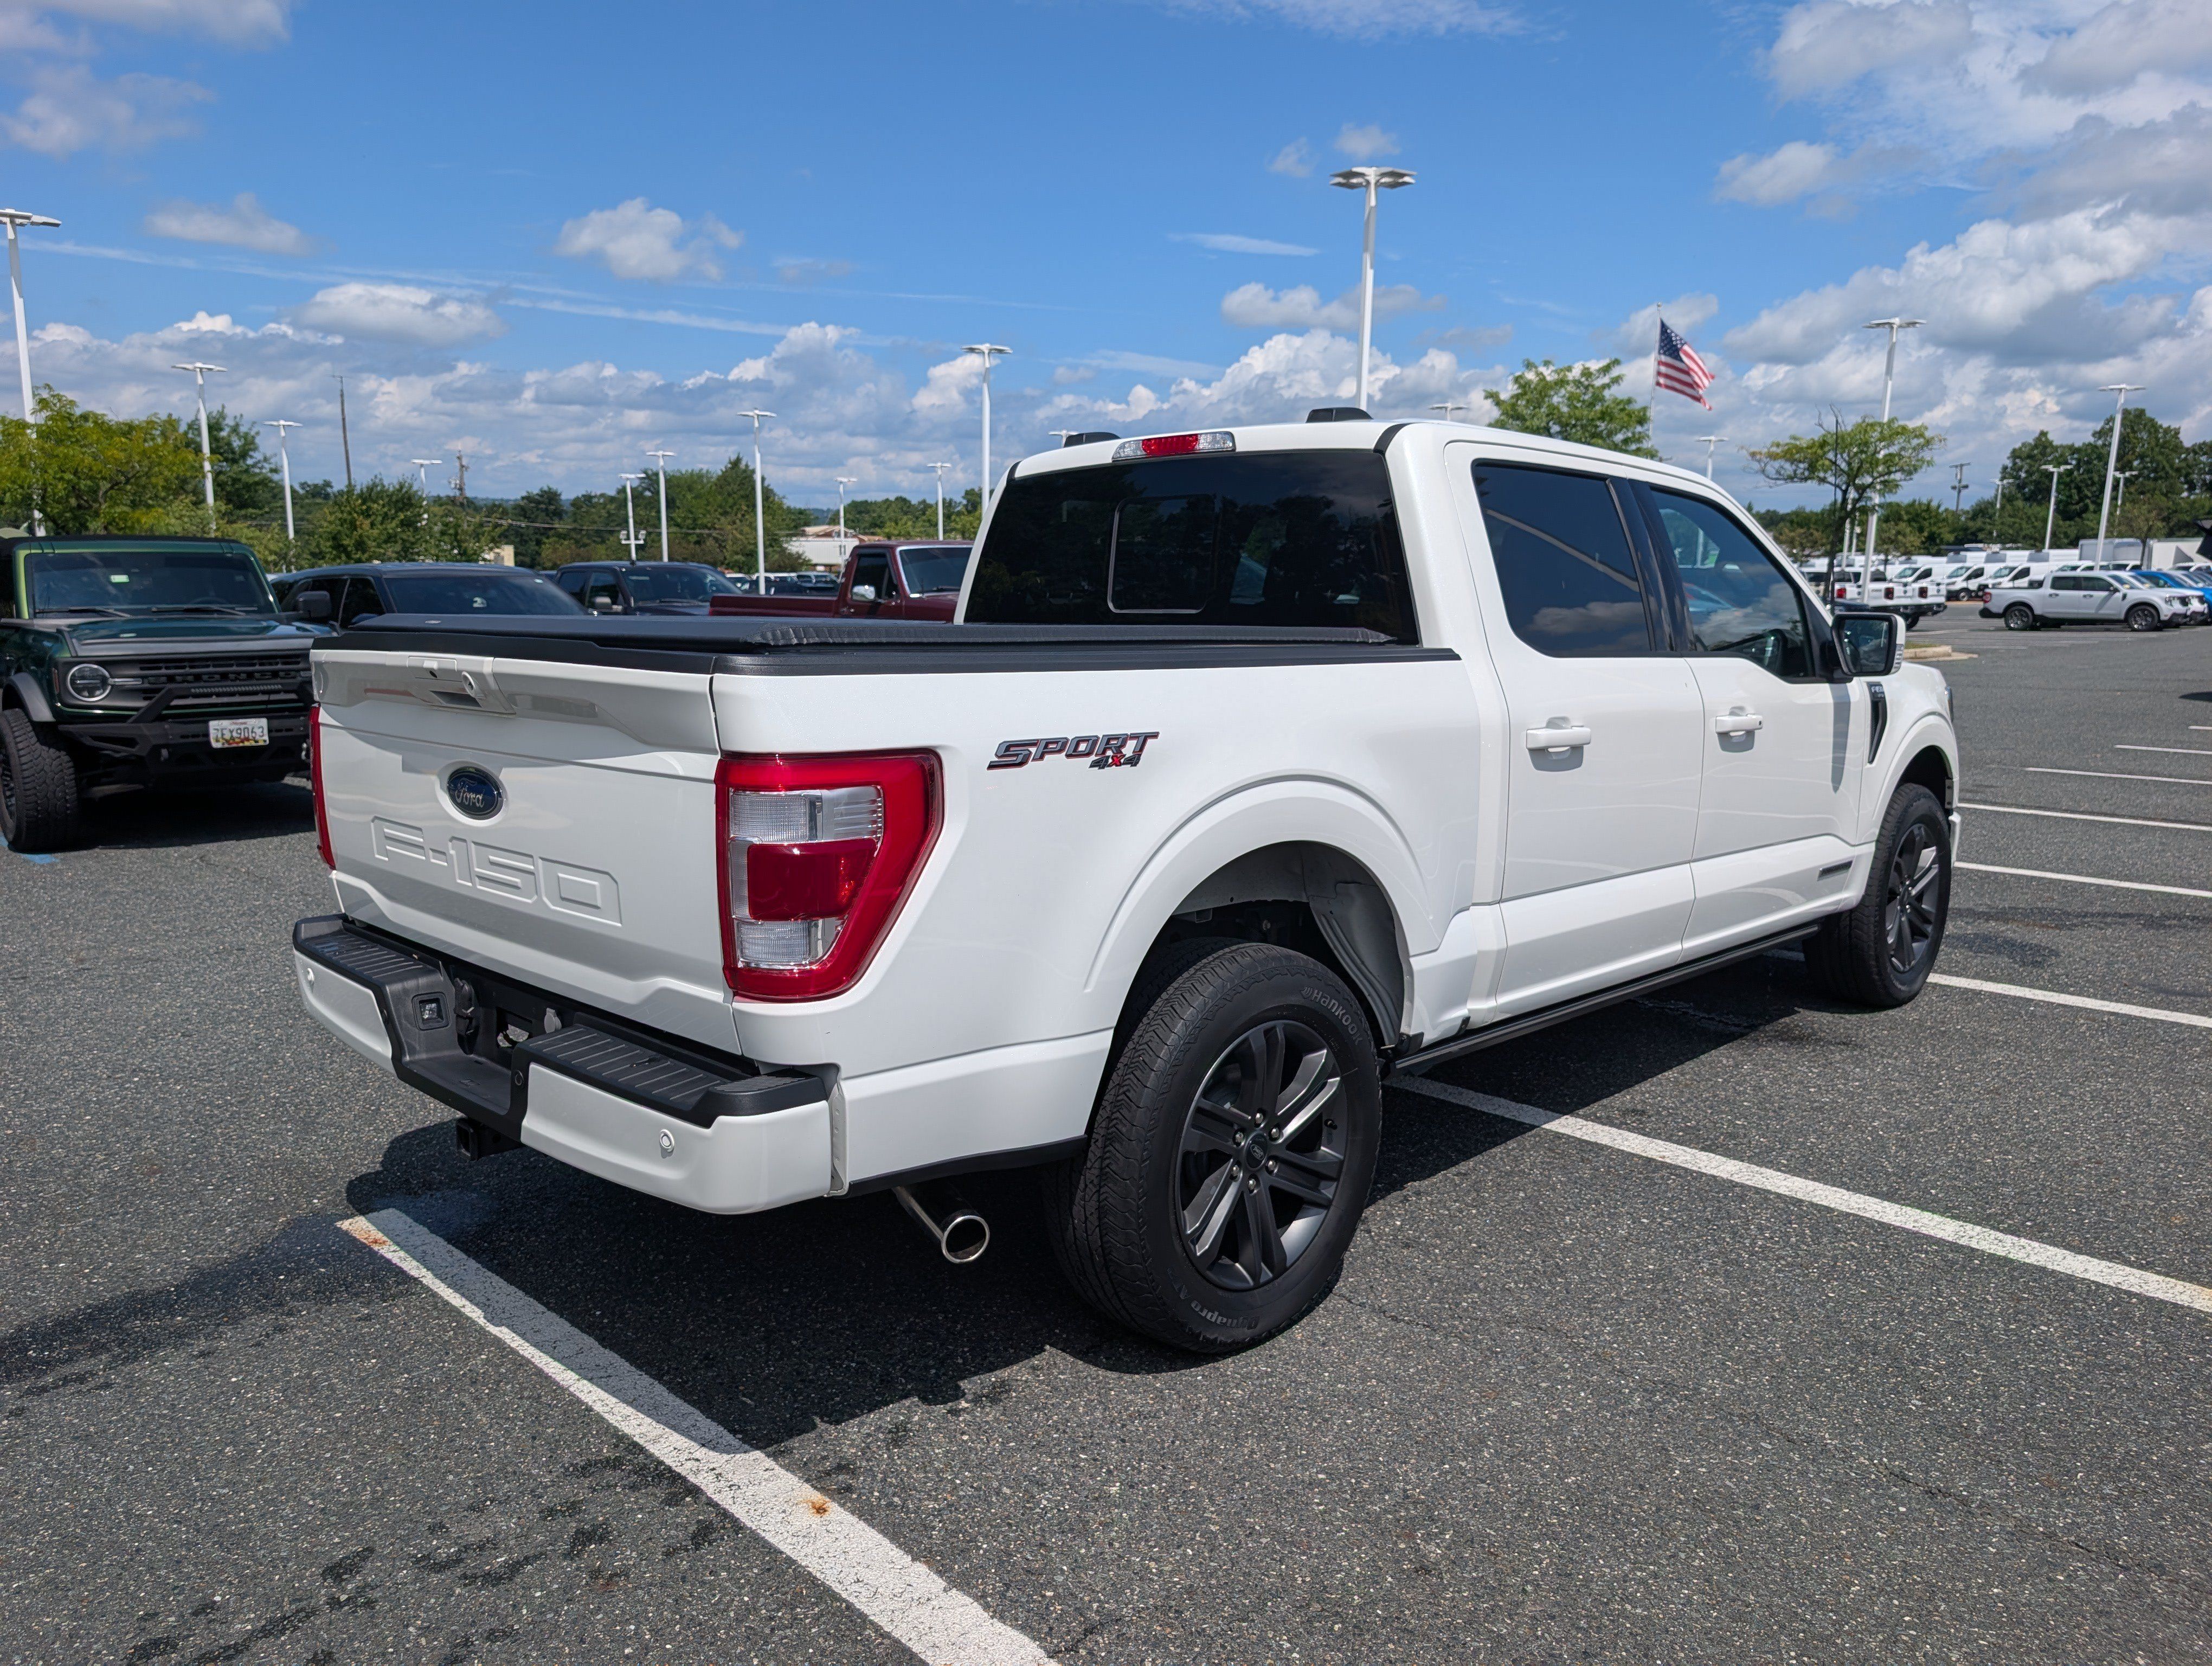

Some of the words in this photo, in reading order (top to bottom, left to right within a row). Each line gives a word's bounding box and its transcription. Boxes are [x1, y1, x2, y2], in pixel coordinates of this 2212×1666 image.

[986, 731, 1160, 771] SPORT
[454, 778, 485, 808] Ford
[371, 816, 623, 927] F-150
